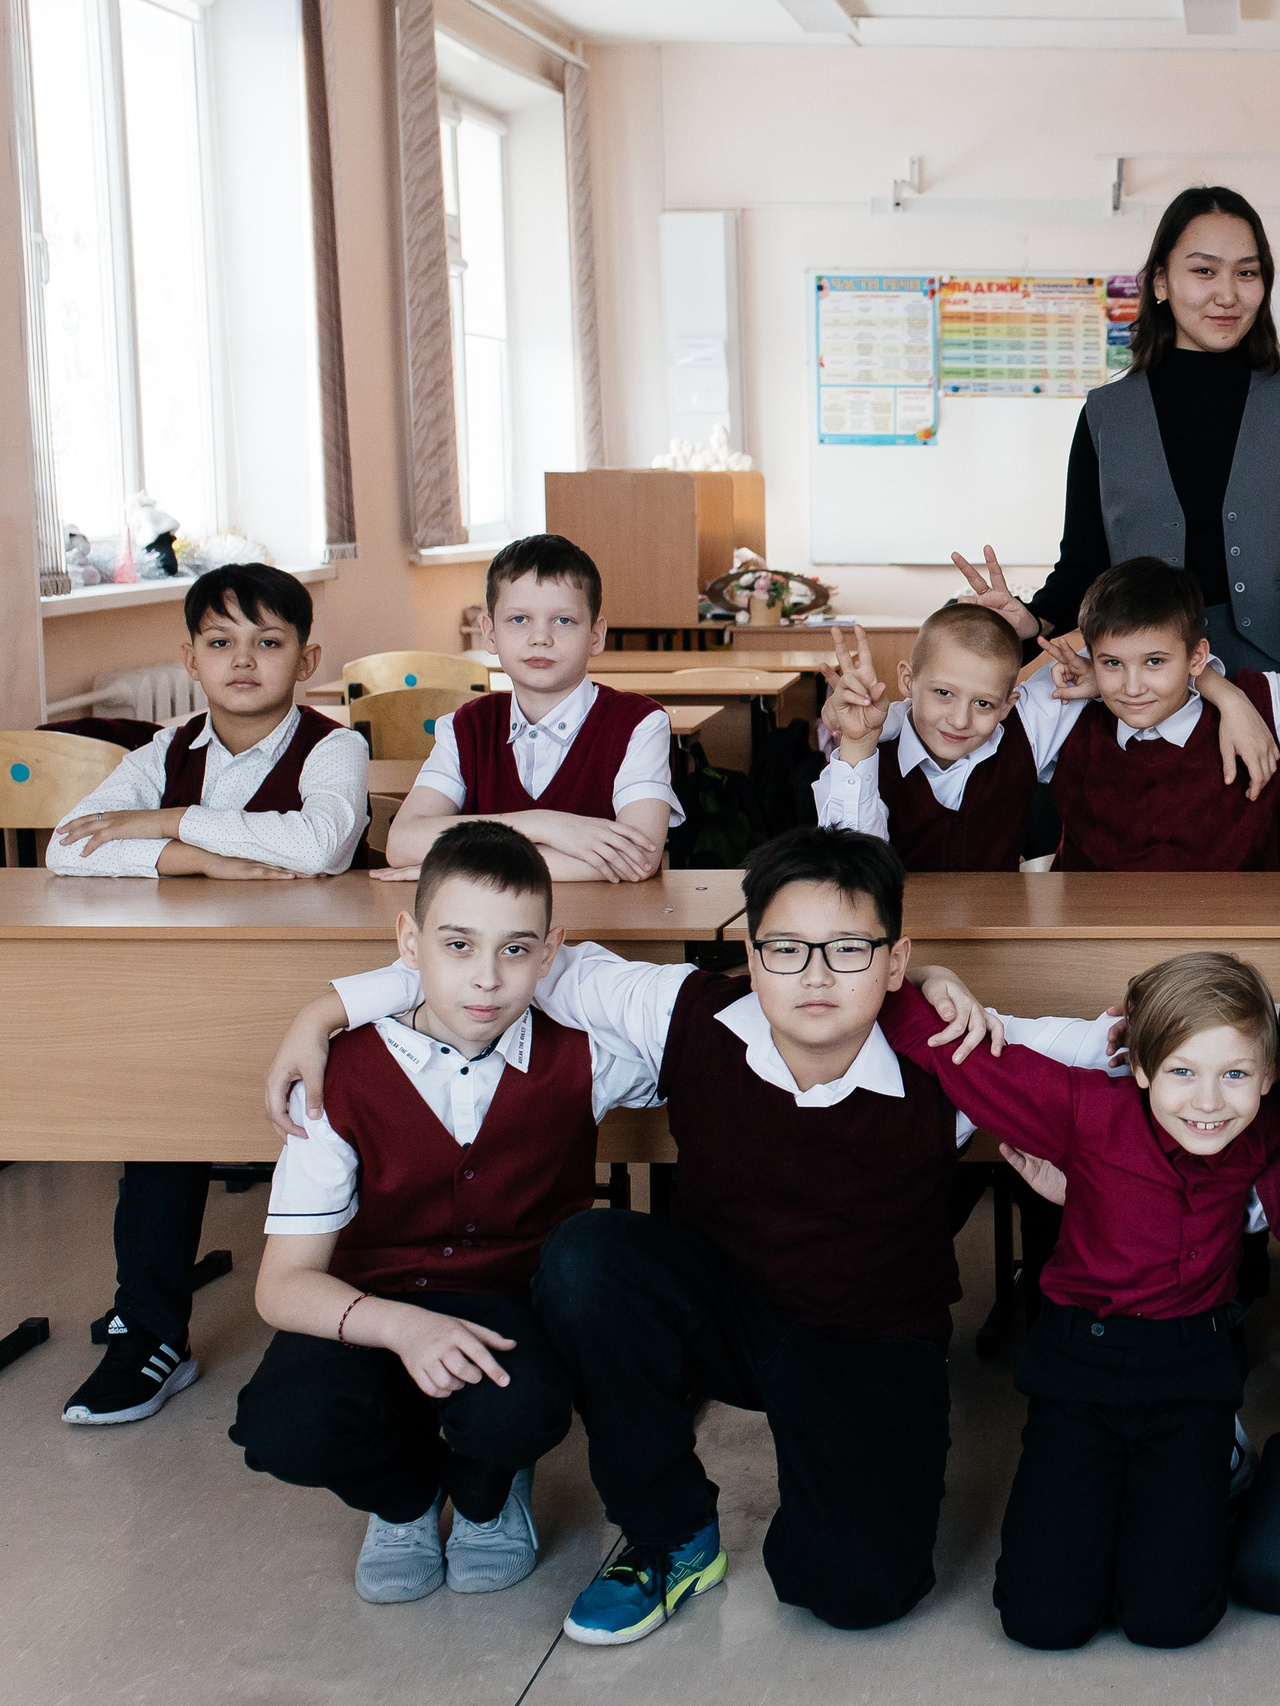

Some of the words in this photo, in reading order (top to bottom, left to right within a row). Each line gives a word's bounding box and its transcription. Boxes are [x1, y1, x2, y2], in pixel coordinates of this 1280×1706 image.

[831, 278, 879, 290] ЧАСТИ
[882, 278, 921, 290] РЕЧИ
[952, 281, 1019, 294] ПАДЕЖИ
[406, 1052, 420, 1065] RULES
